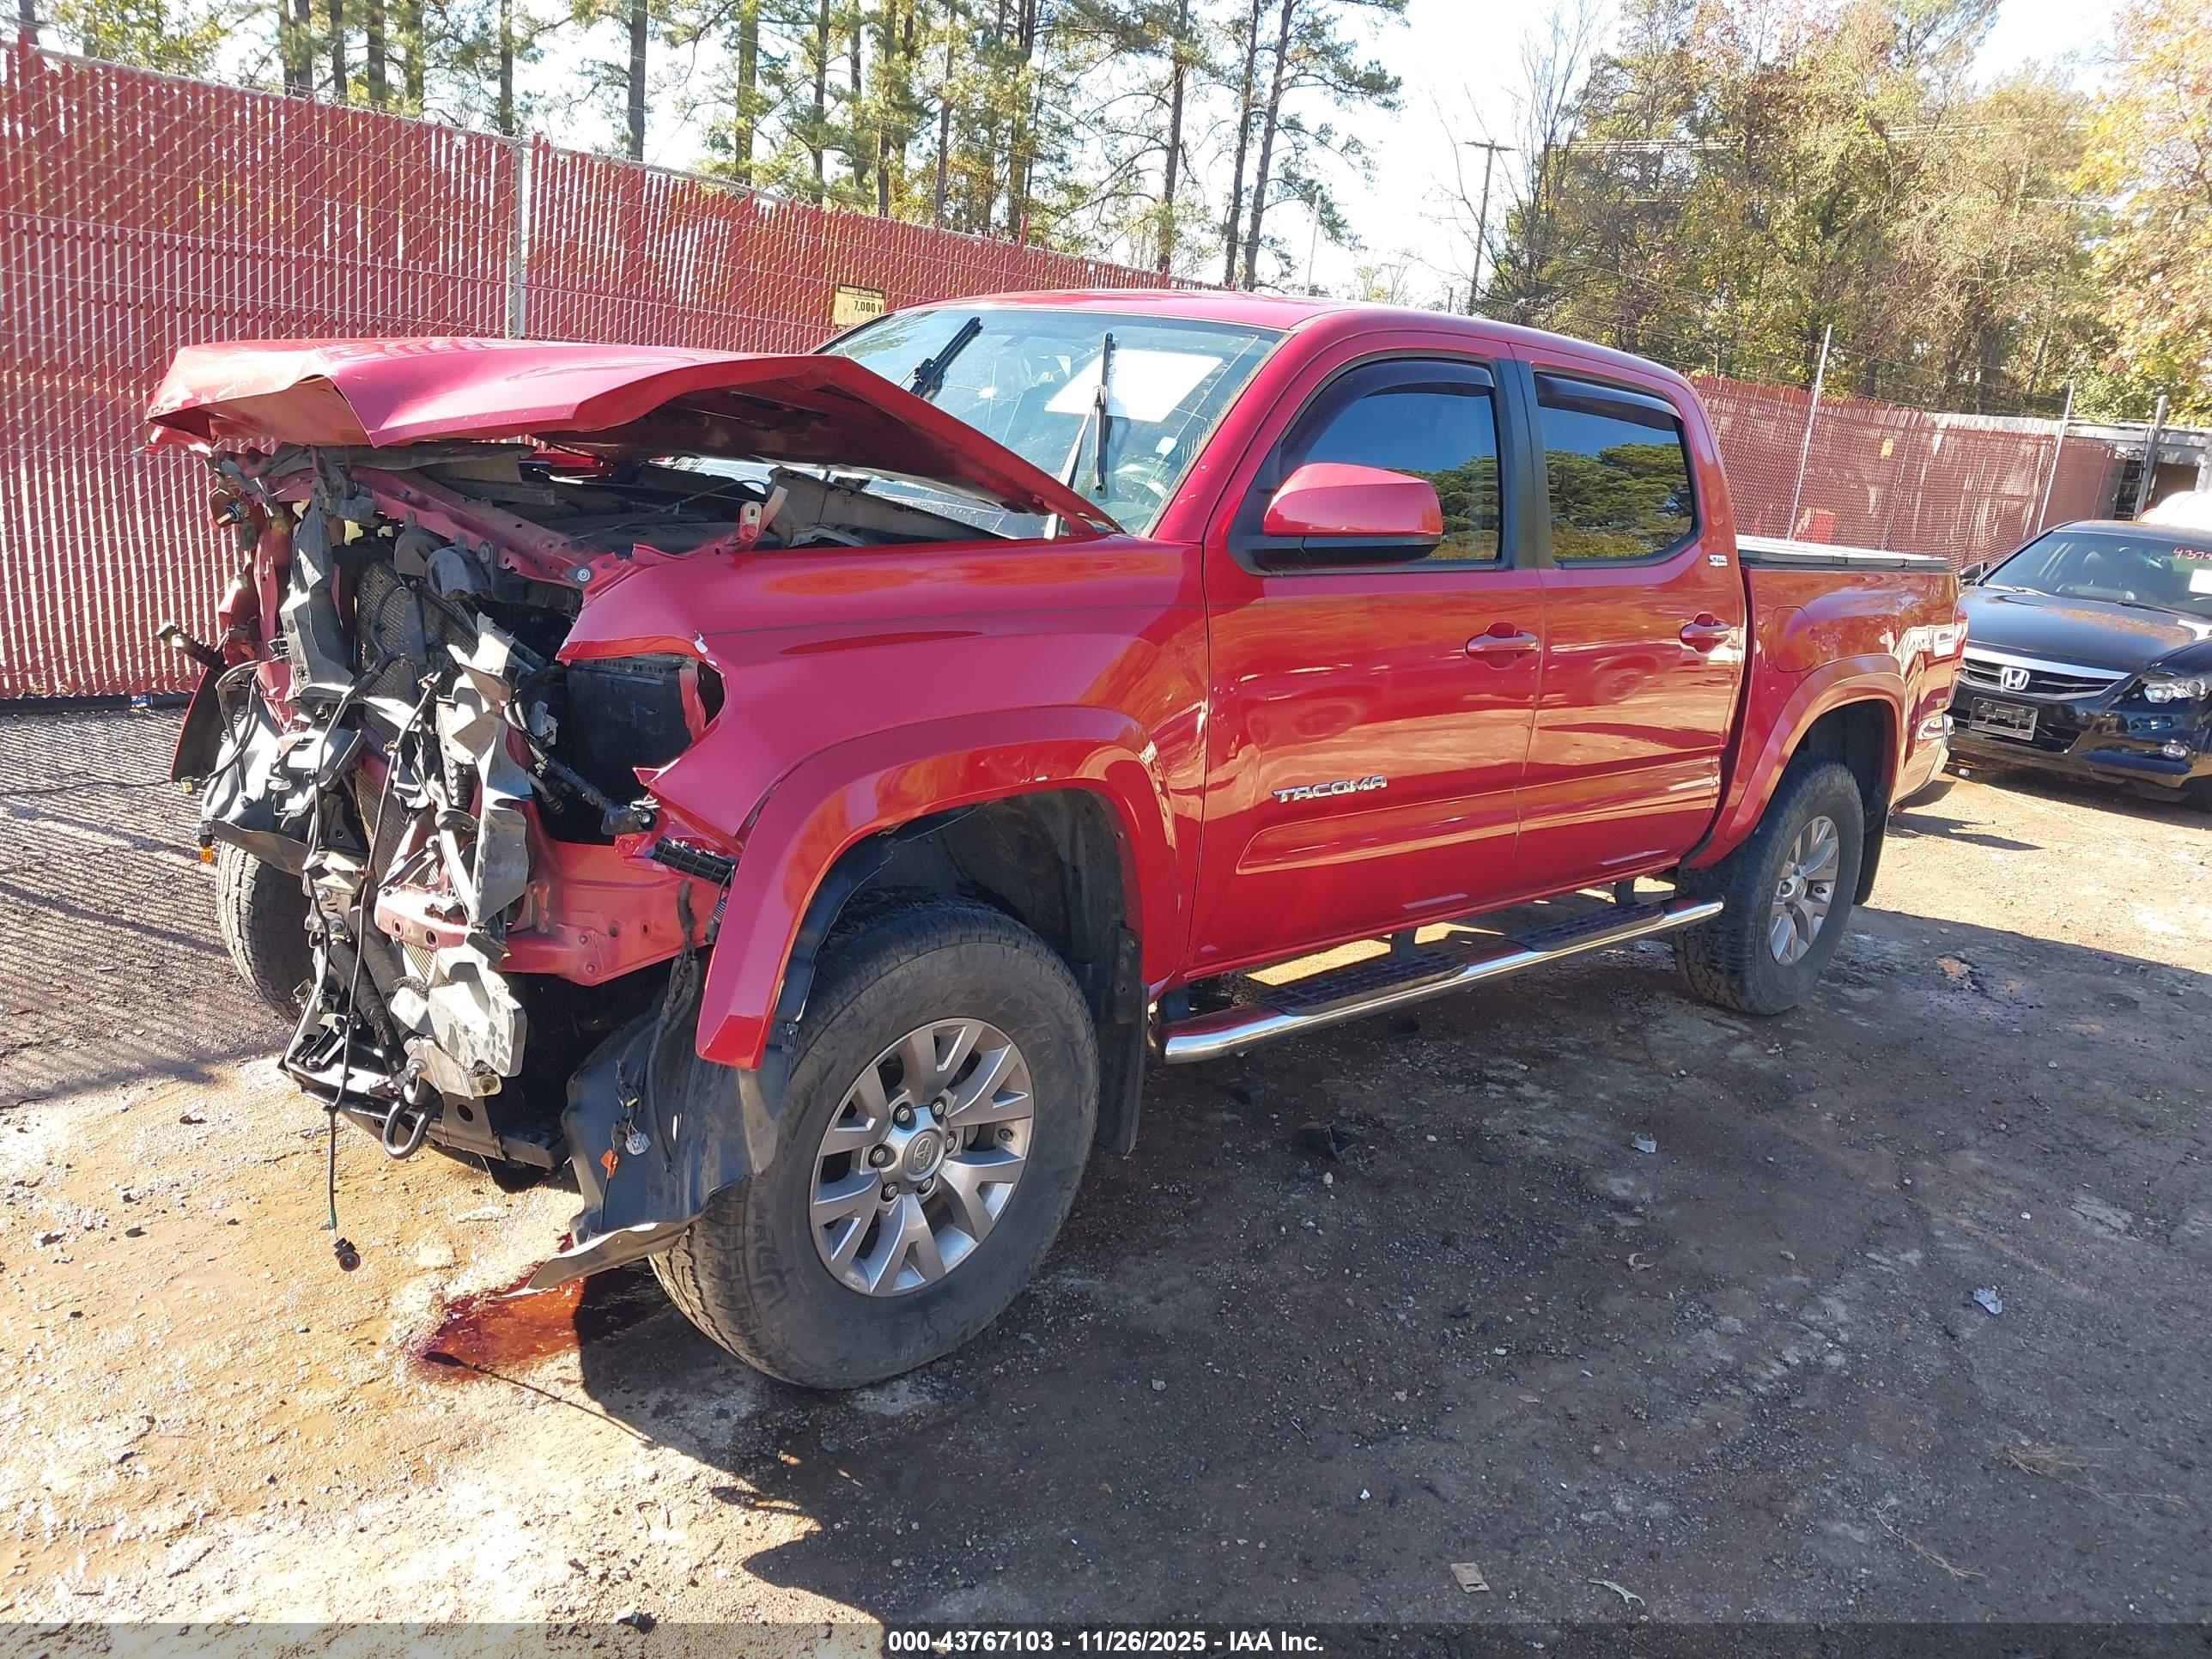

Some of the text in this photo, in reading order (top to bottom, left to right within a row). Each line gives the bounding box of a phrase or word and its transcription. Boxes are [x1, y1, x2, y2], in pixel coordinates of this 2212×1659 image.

[854, 301, 883, 313] 7,000 V
[1273, 775, 1388, 804] TACOMA
